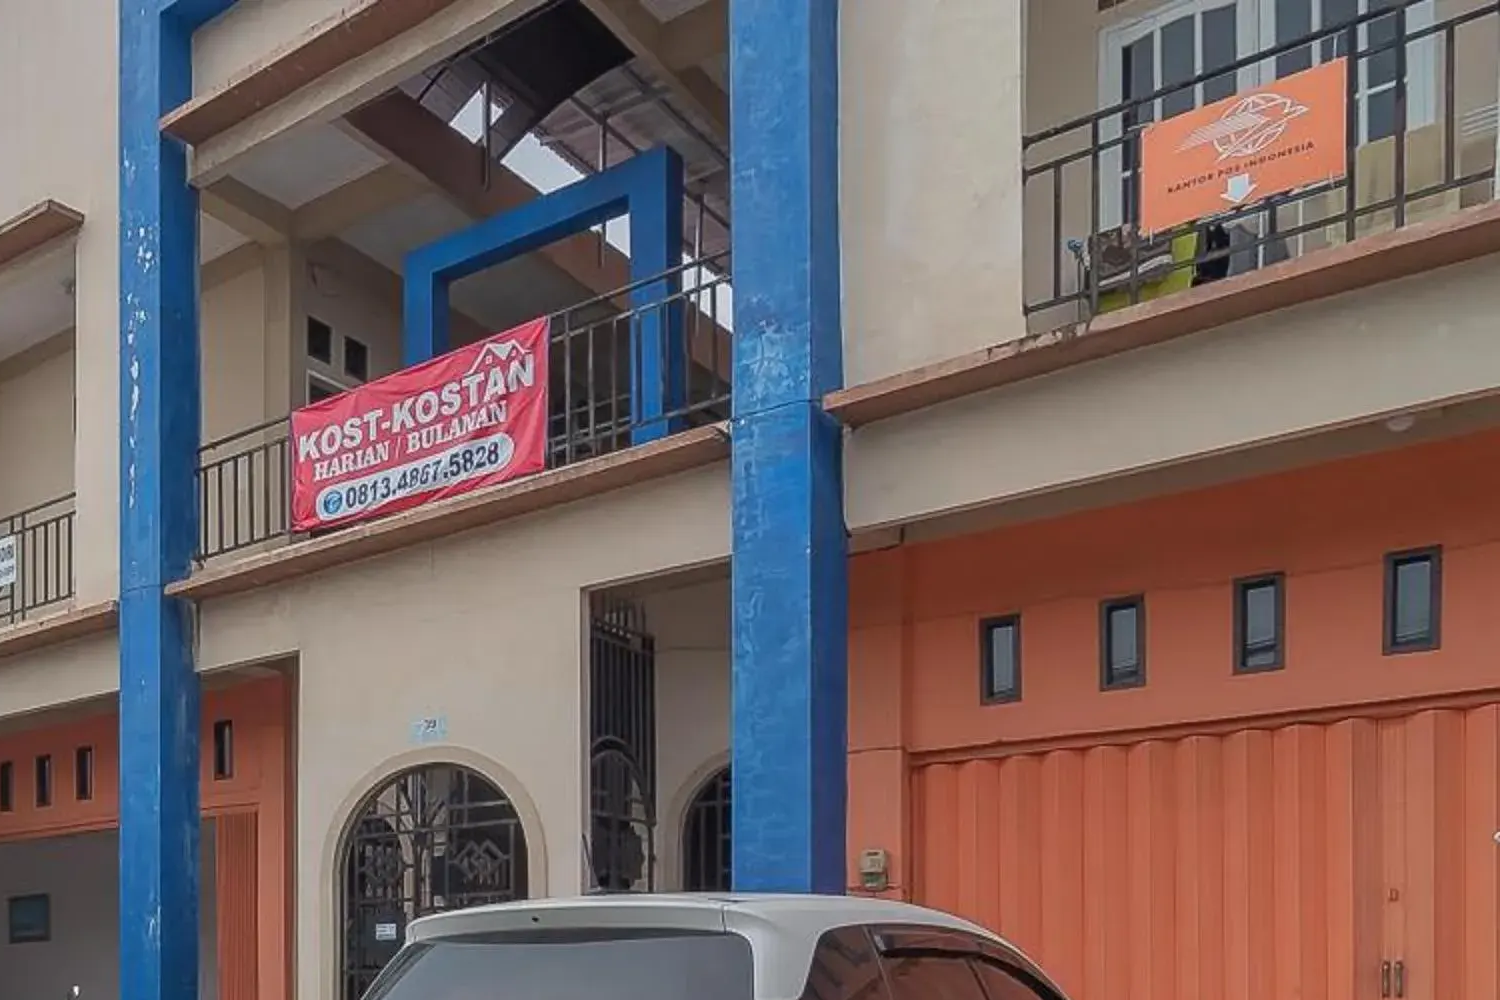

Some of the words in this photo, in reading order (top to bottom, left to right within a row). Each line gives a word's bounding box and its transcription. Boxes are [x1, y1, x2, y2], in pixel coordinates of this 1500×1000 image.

[1168, 175, 1213, 194] KANTOR
[1244, 141, 1314, 168] INDONESIA
[300, 354, 535, 462] KOST-KOSTAN
[314, 441, 390, 482] HARIAN
[406, 400, 508, 453] BULANAN
